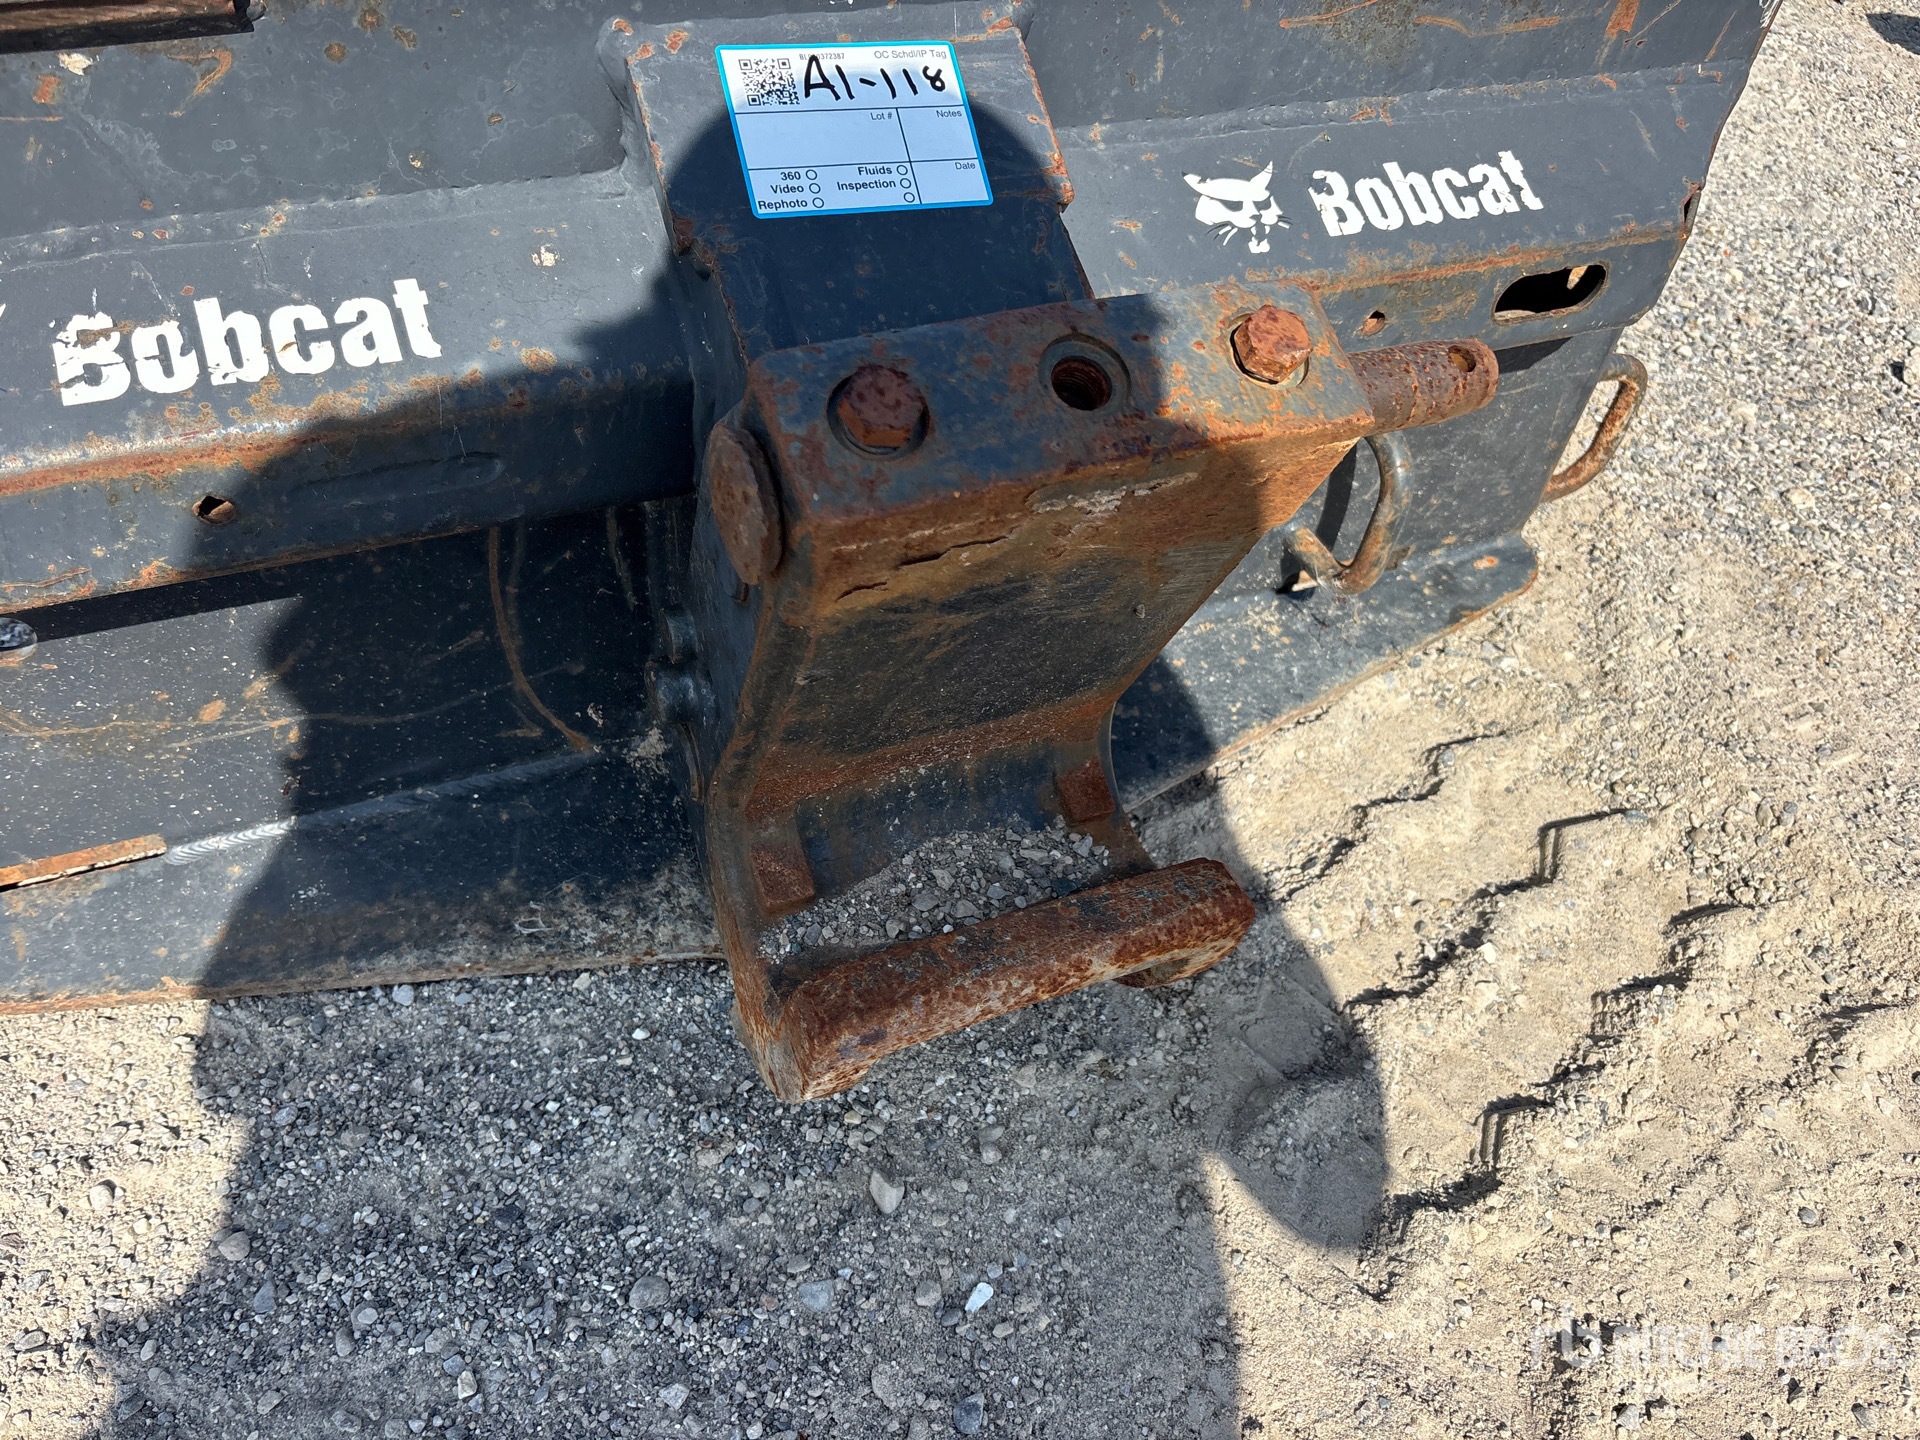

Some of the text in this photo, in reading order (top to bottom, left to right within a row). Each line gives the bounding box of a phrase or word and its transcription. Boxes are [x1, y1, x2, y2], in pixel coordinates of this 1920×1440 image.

[873, 50, 890, 59] OC
[929, 49, 947, 60] Tag
[870, 111, 893, 121] Lot #
[936, 109, 962, 118] Notes
[857, 165, 893, 176] Fluids
[955, 161, 976, 170] Date
[780, 171, 801, 181] 360
[770, 184, 804, 194] Video
[837, 178, 896, 192] Inspection
[1308, 150, 1543, 237] Bobcat
[758, 199, 808, 211] Rephoto
[52, 278, 442, 406] Bobcat
